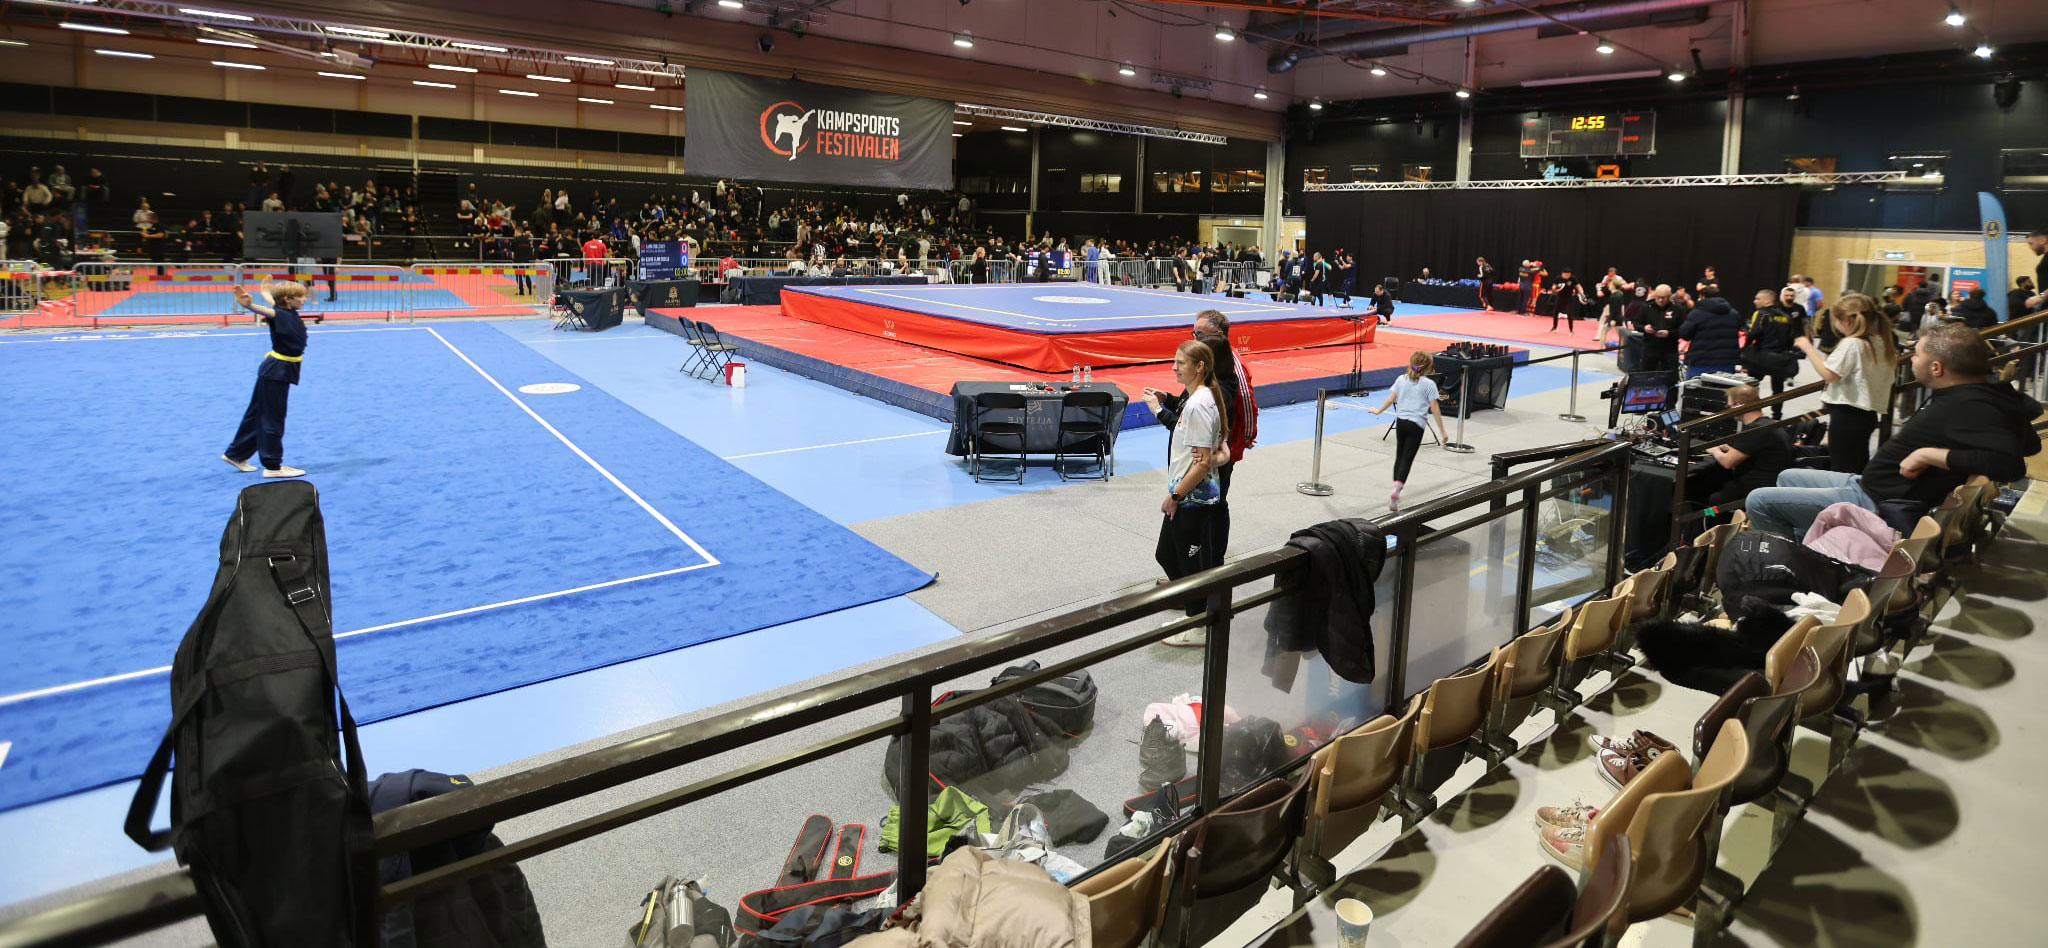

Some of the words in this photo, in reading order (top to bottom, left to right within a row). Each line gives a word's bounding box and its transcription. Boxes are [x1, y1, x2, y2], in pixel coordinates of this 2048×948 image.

[817, 109, 900, 137] KAMPSPORTS
[1571, 115, 1606, 130] 12:55
[816, 131, 899, 160] FESTIVALEN
[681, 242, 687, 254] 0
[681, 255, 687, 266] 0
